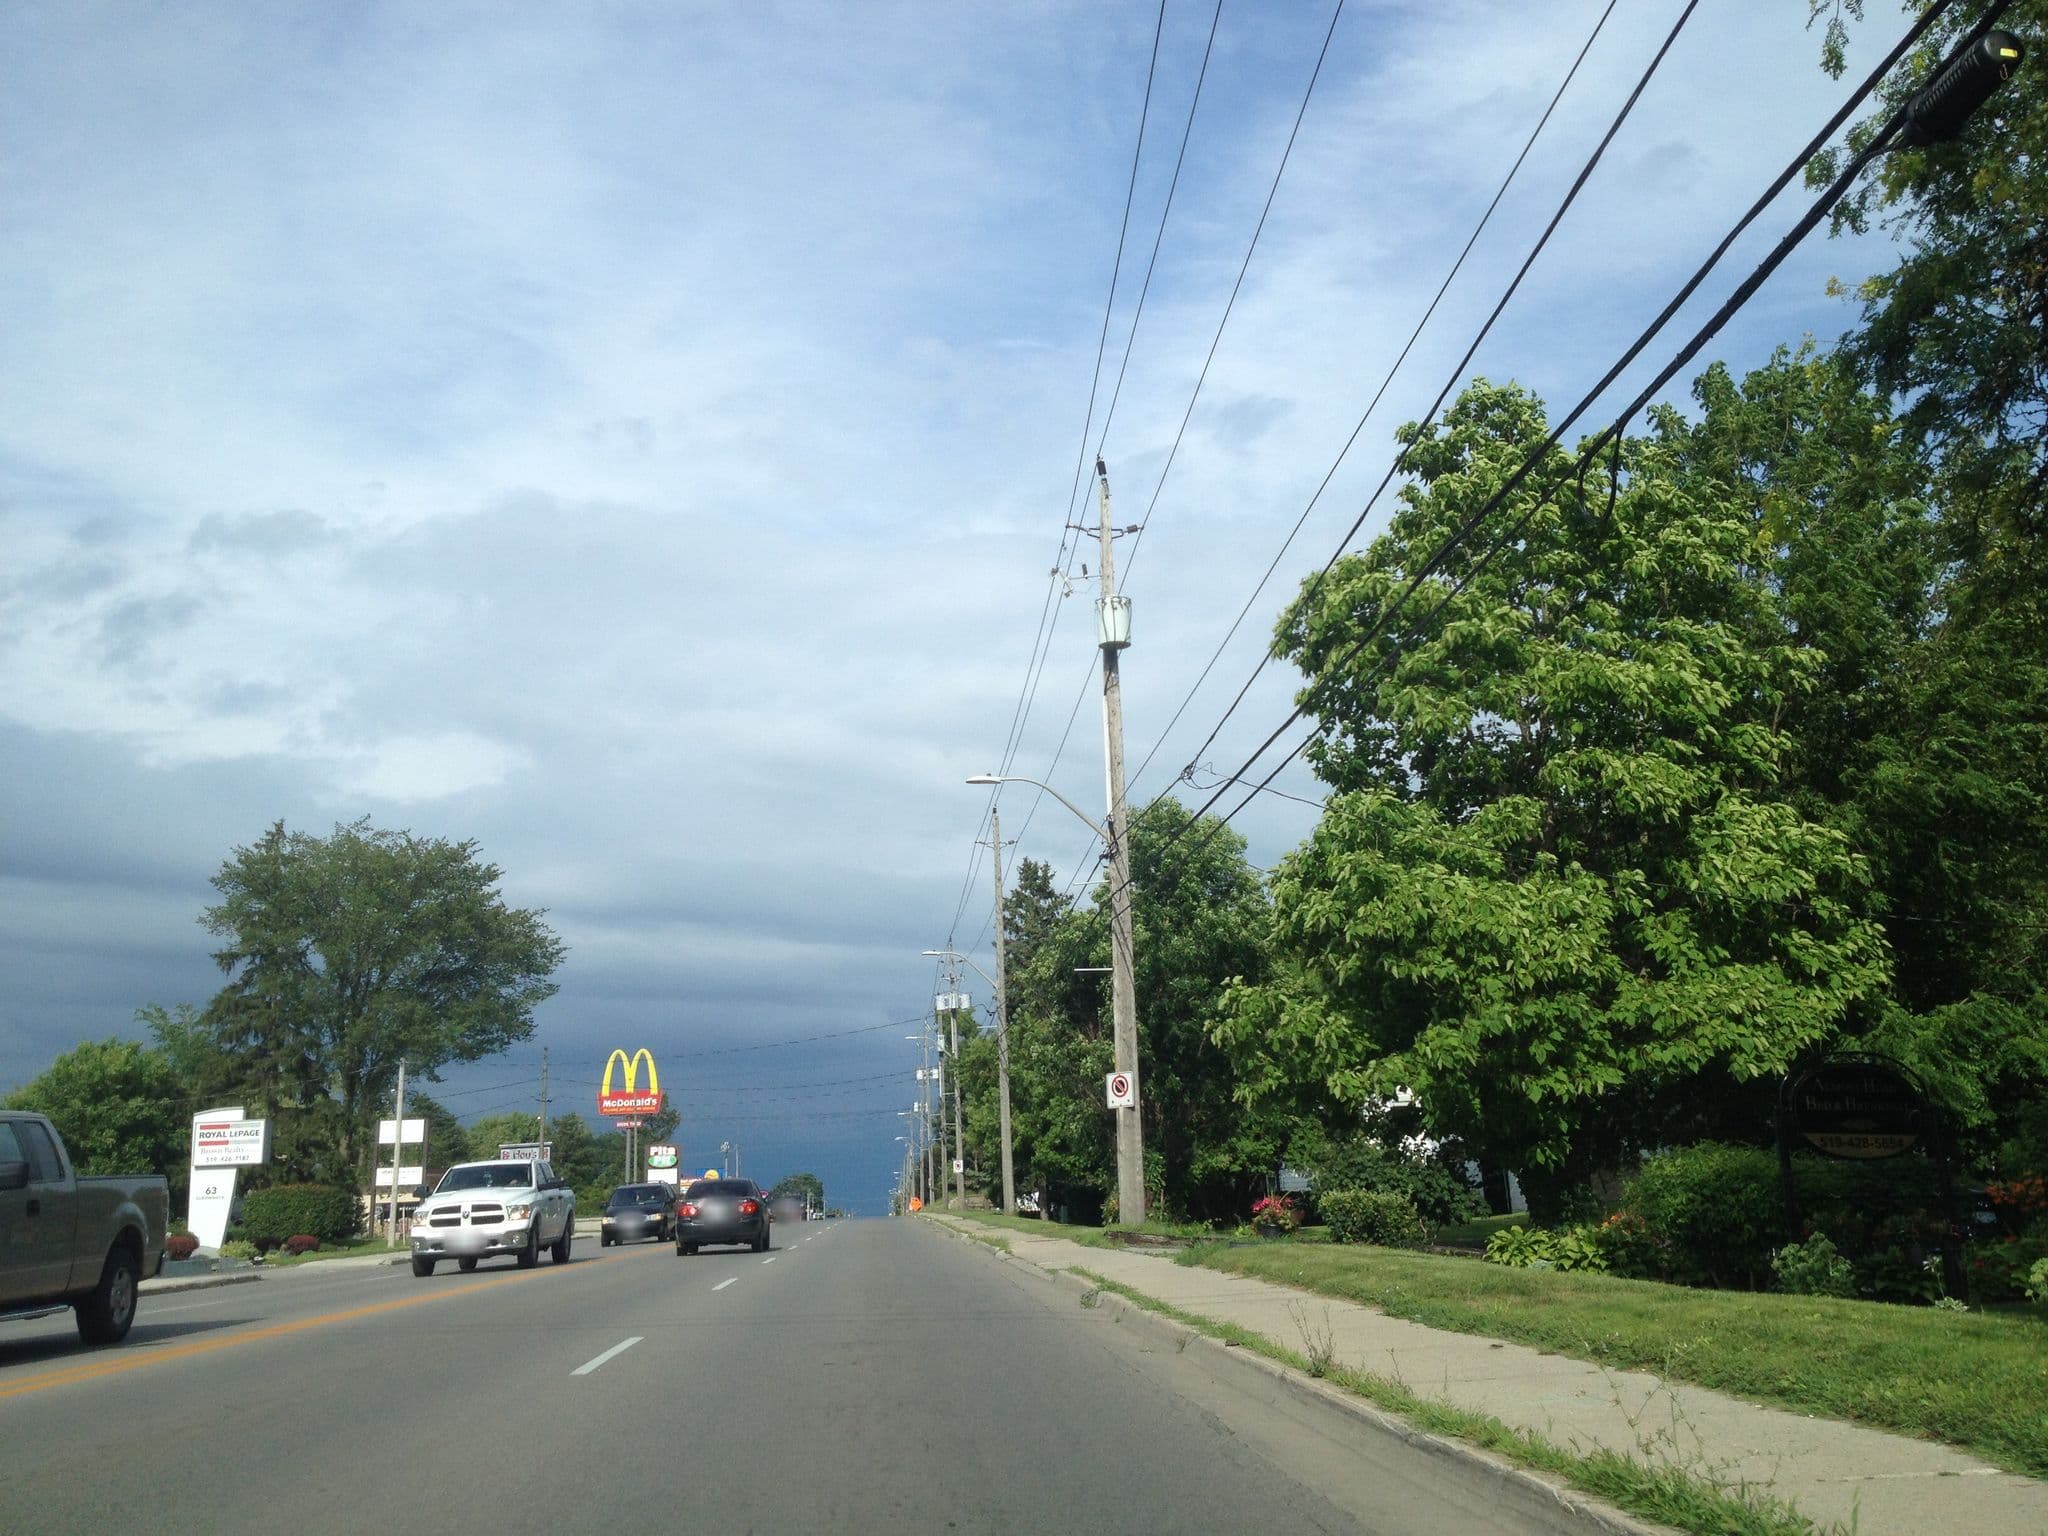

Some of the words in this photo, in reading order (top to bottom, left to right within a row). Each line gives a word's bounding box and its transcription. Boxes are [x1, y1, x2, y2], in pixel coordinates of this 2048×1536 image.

[602, 1097, 658, 1108] McDonald's
[199, 1131, 227, 1139] ROYAL
[205, 1187, 217, 1195] 63
